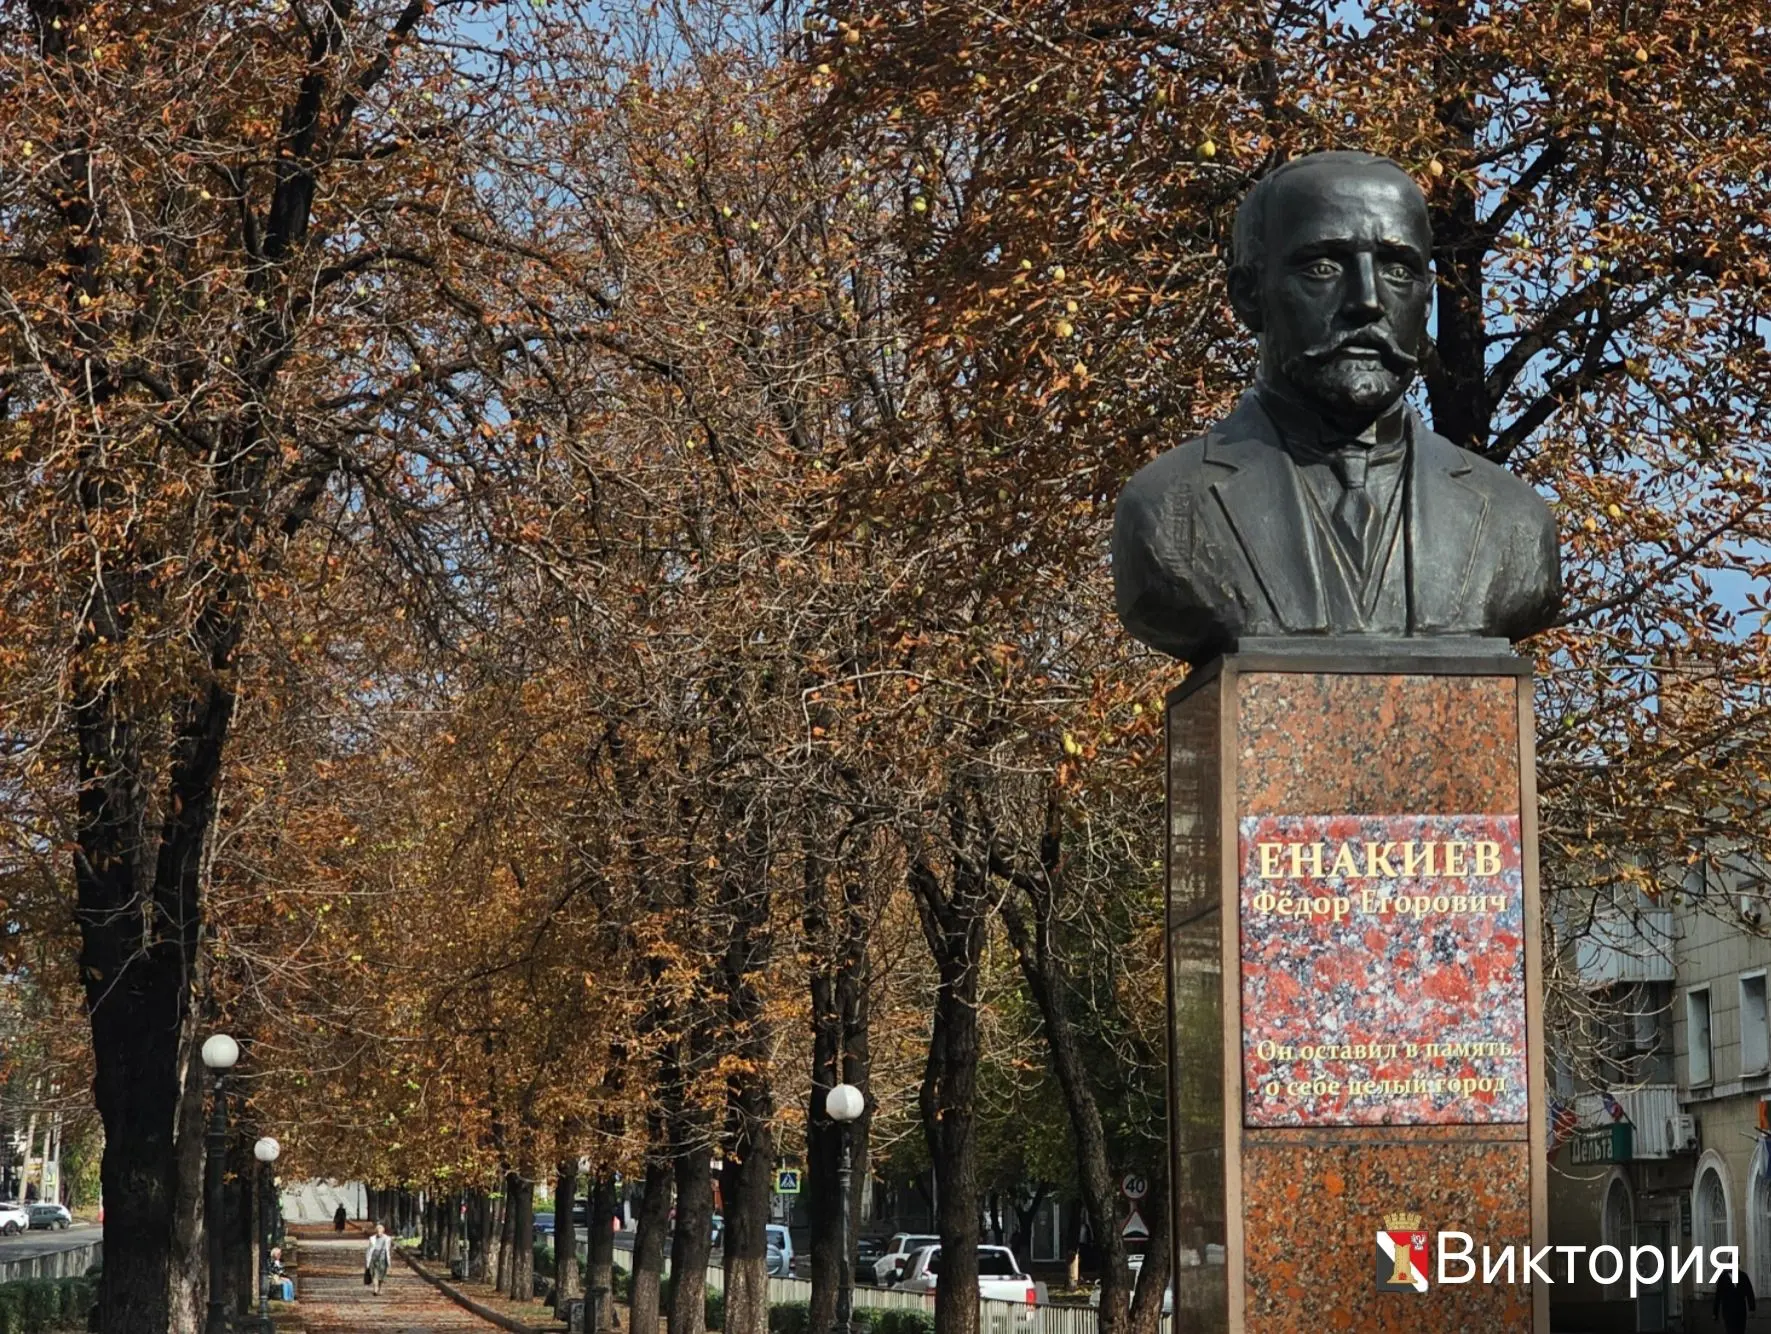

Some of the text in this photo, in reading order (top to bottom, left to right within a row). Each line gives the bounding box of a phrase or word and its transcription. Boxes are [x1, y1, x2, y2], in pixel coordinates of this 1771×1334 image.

[1257, 841, 1502, 879] ЕНАКИЕВ
[1253, 889, 1508, 922] Фёдор Егорович
[1257, 1040, 1513, 1061] Он оставил в память
[1265, 1072, 1507, 1100] о себе целый город
[1125, 1178, 1146, 1194] 40
